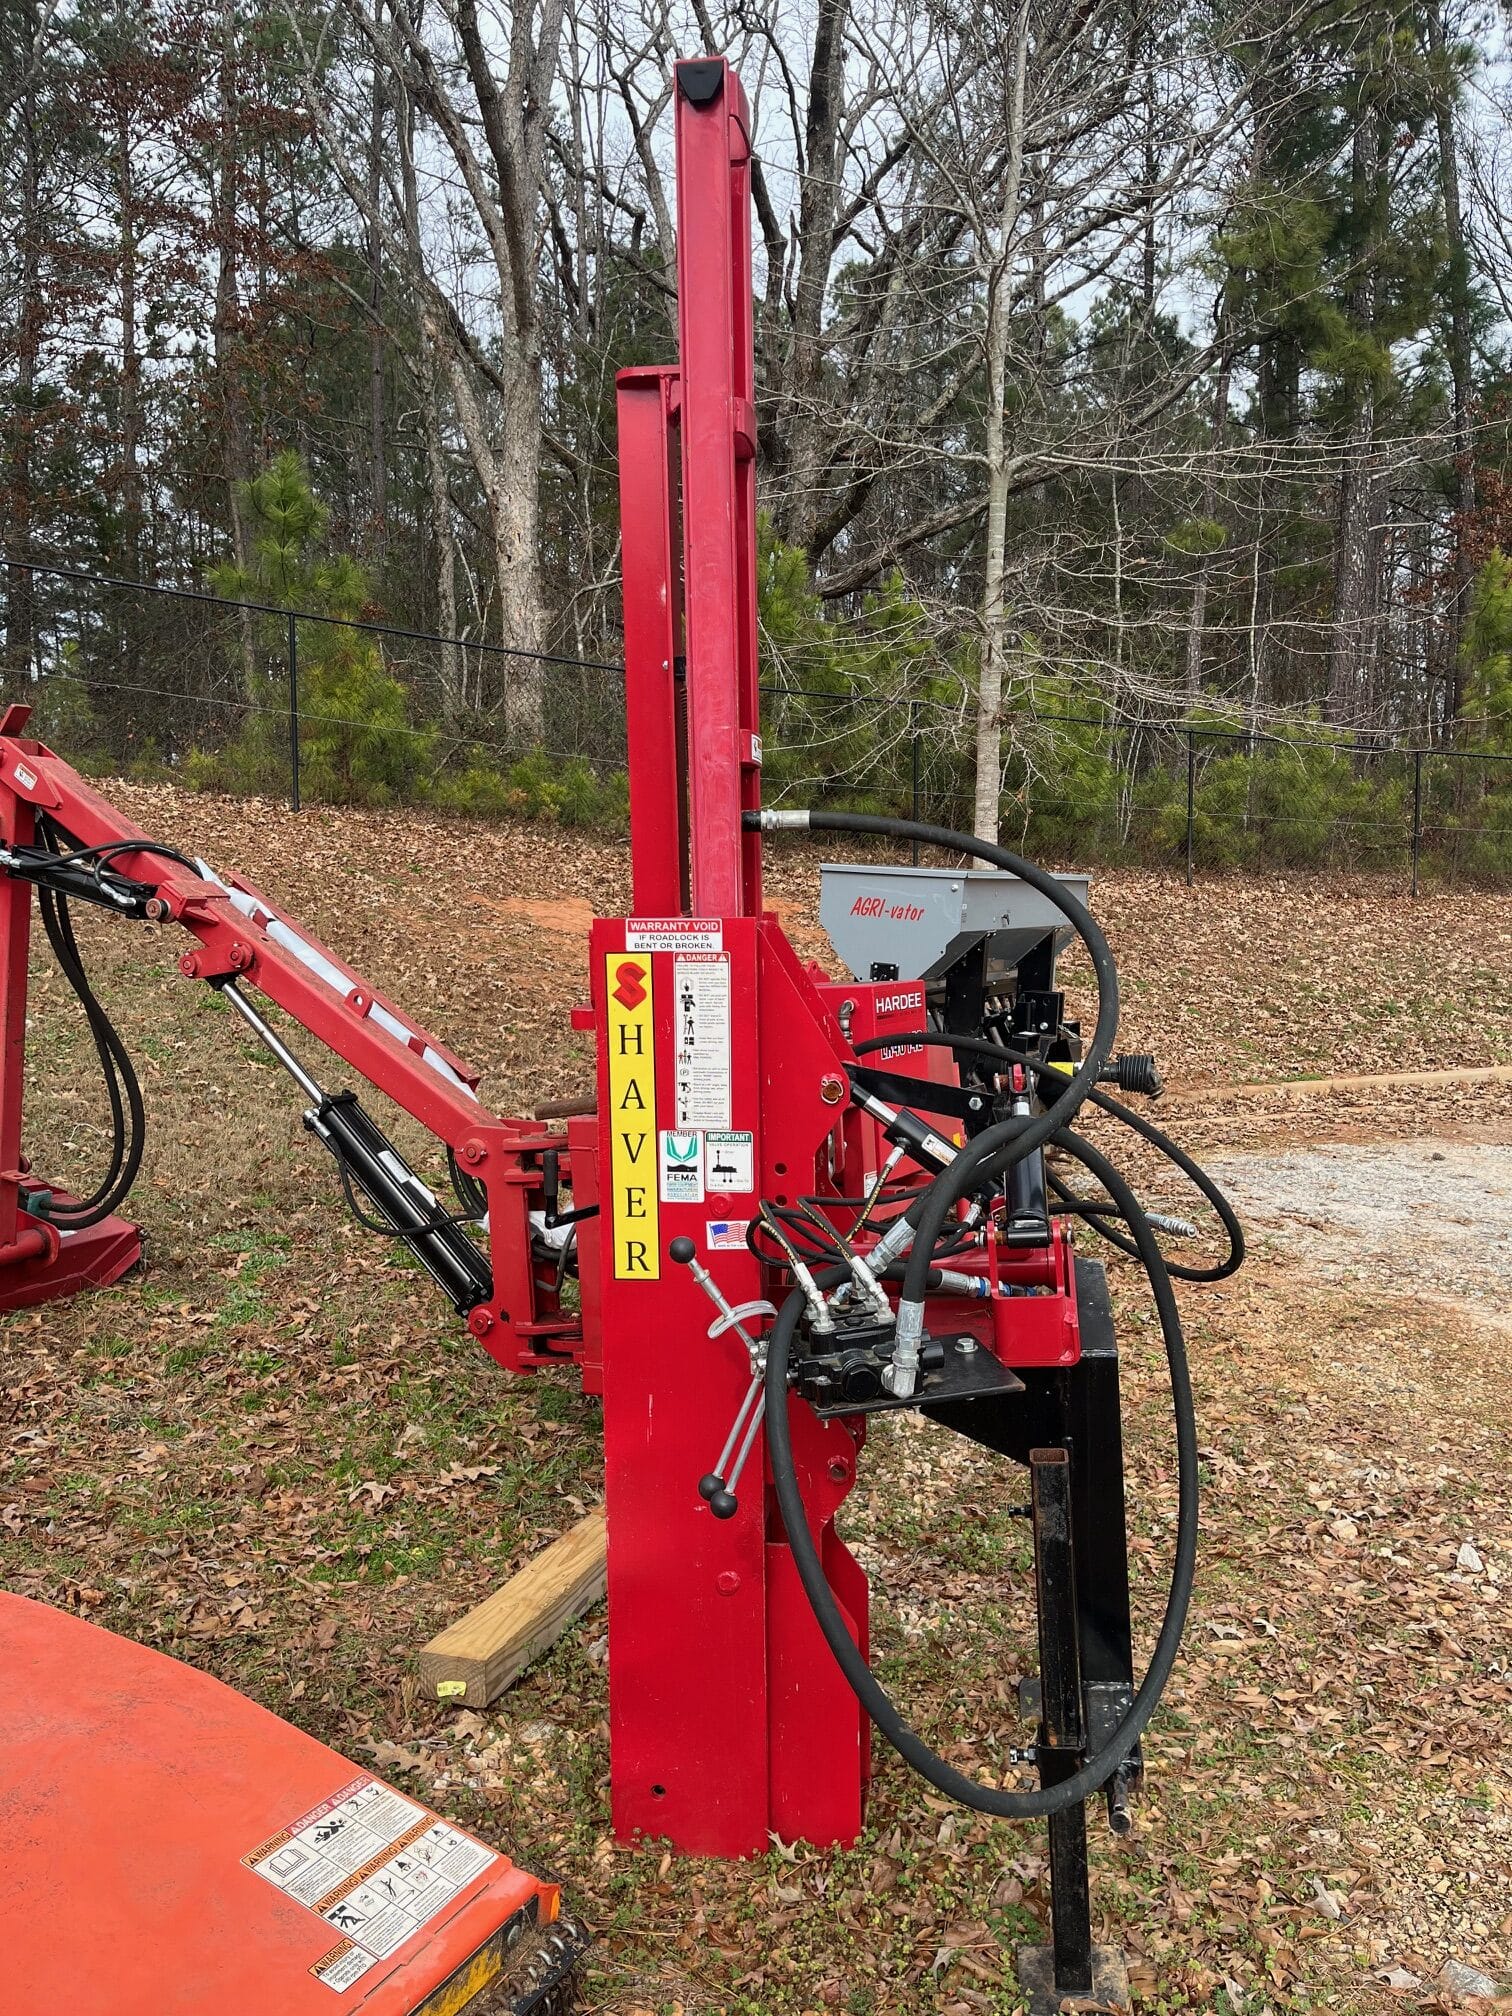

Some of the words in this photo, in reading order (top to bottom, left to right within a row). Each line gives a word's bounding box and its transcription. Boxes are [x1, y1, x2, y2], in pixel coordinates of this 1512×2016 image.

[850, 896, 925, 921] AGRI-vator
[630, 922, 690, 931] WARRANTY
[693, 922, 718, 931] VOID
[876, 992, 922, 1014] HARDEE
[708, 1132, 750, 1141] IMPORTANT
[666, 1173, 698, 1182] FEMA
[336, 1776, 371, 1801] DANGER
[299, 1802, 332, 1826] DANGER
[403, 1816, 435, 1843] WARNING
[255, 1831, 291, 1857] WARNING
[365, 1846, 398, 1873] WARNING
[325, 1877, 359, 1906] WARNING
[319, 1941, 352, 1967] WARNING
